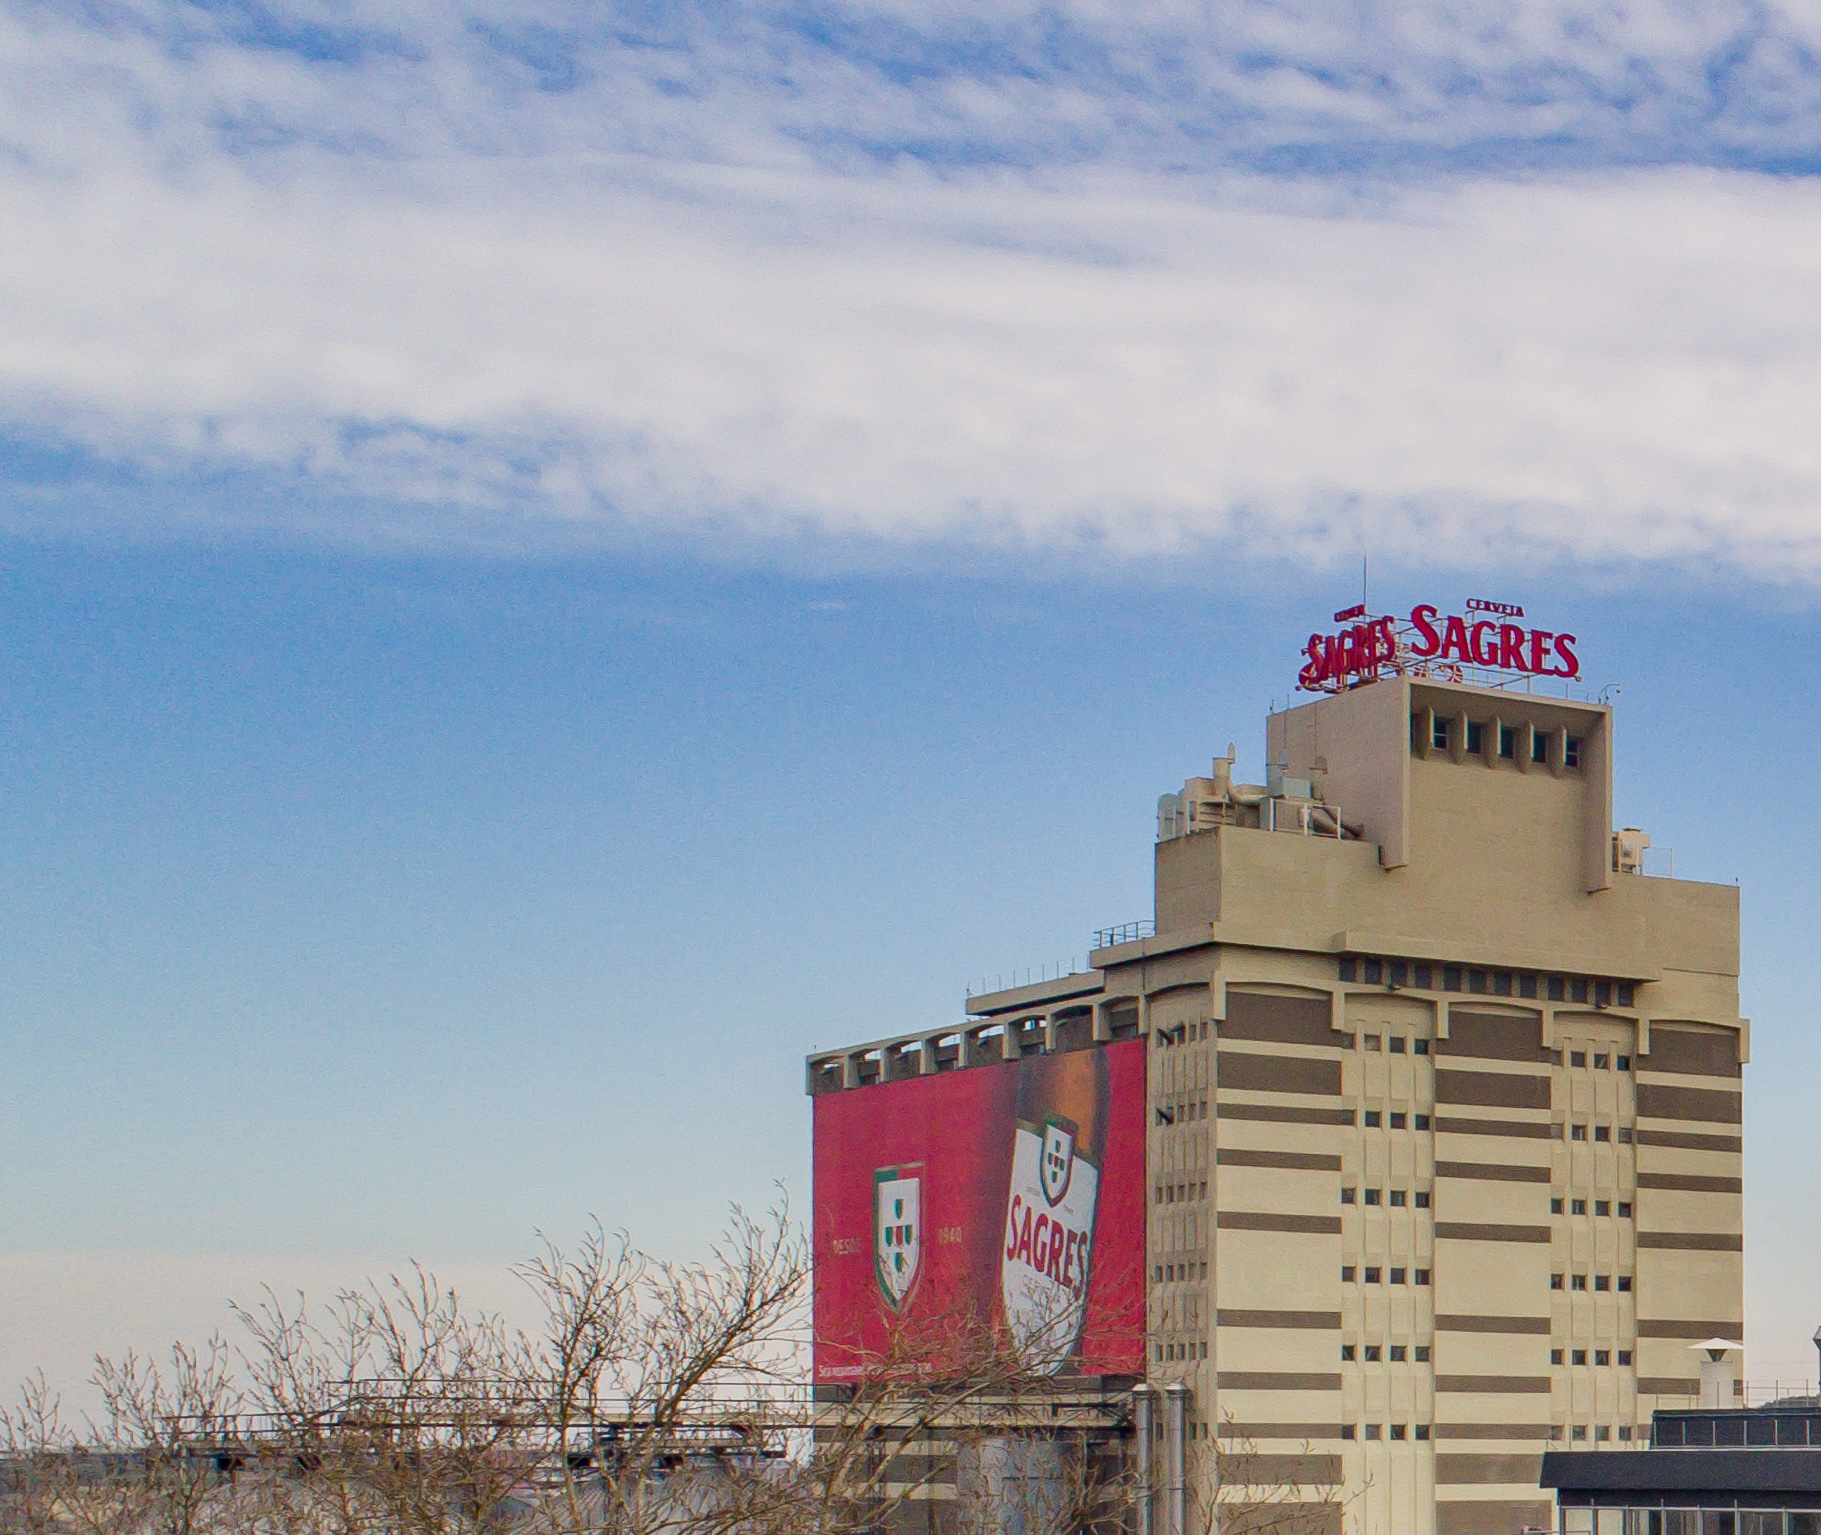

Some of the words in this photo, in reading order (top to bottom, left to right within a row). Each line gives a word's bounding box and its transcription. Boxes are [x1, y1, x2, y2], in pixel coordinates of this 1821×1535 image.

[1411, 604, 1580, 678] SAGRES
[1467, 598, 1525, 617] CERVEJA
[1299, 615, 1396, 687] SAGRES
[1007, 1194, 1088, 1294] SAGRES
